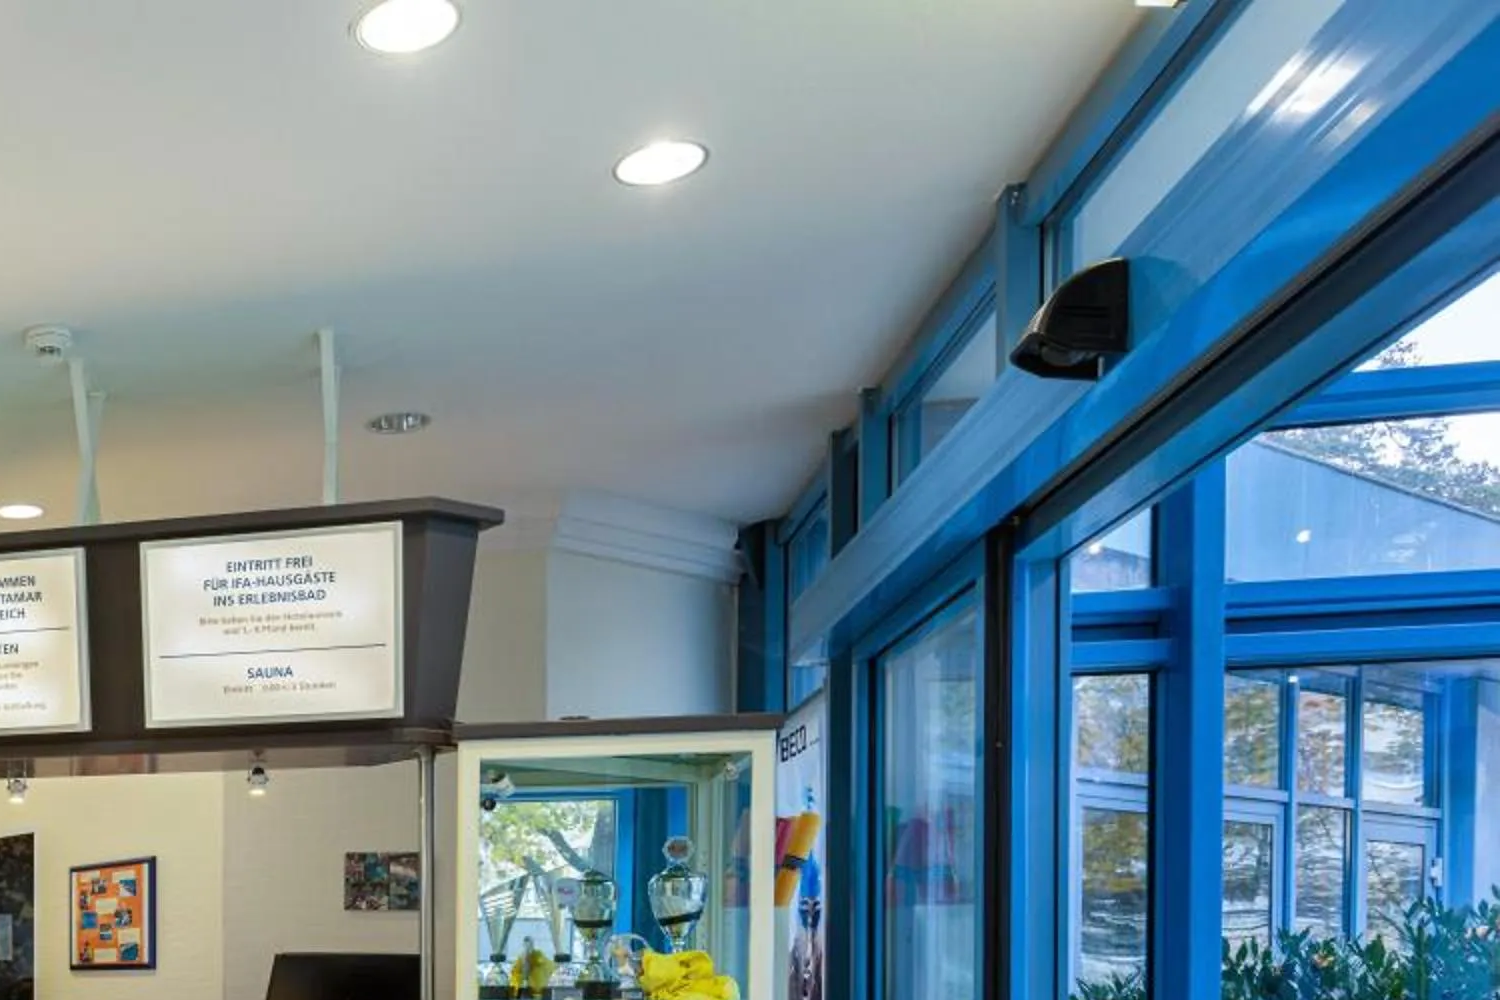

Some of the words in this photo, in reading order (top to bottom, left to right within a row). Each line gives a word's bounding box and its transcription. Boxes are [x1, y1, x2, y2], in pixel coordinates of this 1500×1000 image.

[227, 559, 282, 573] EINTRITT
[286, 556, 313, 568] FREI
[203, 578, 228, 591] FÜR
[213, 595, 234, 607] INS
[239, 589, 326, 605] ERLEBNISBAD
[247, 665, 294, 679] SAUNA
